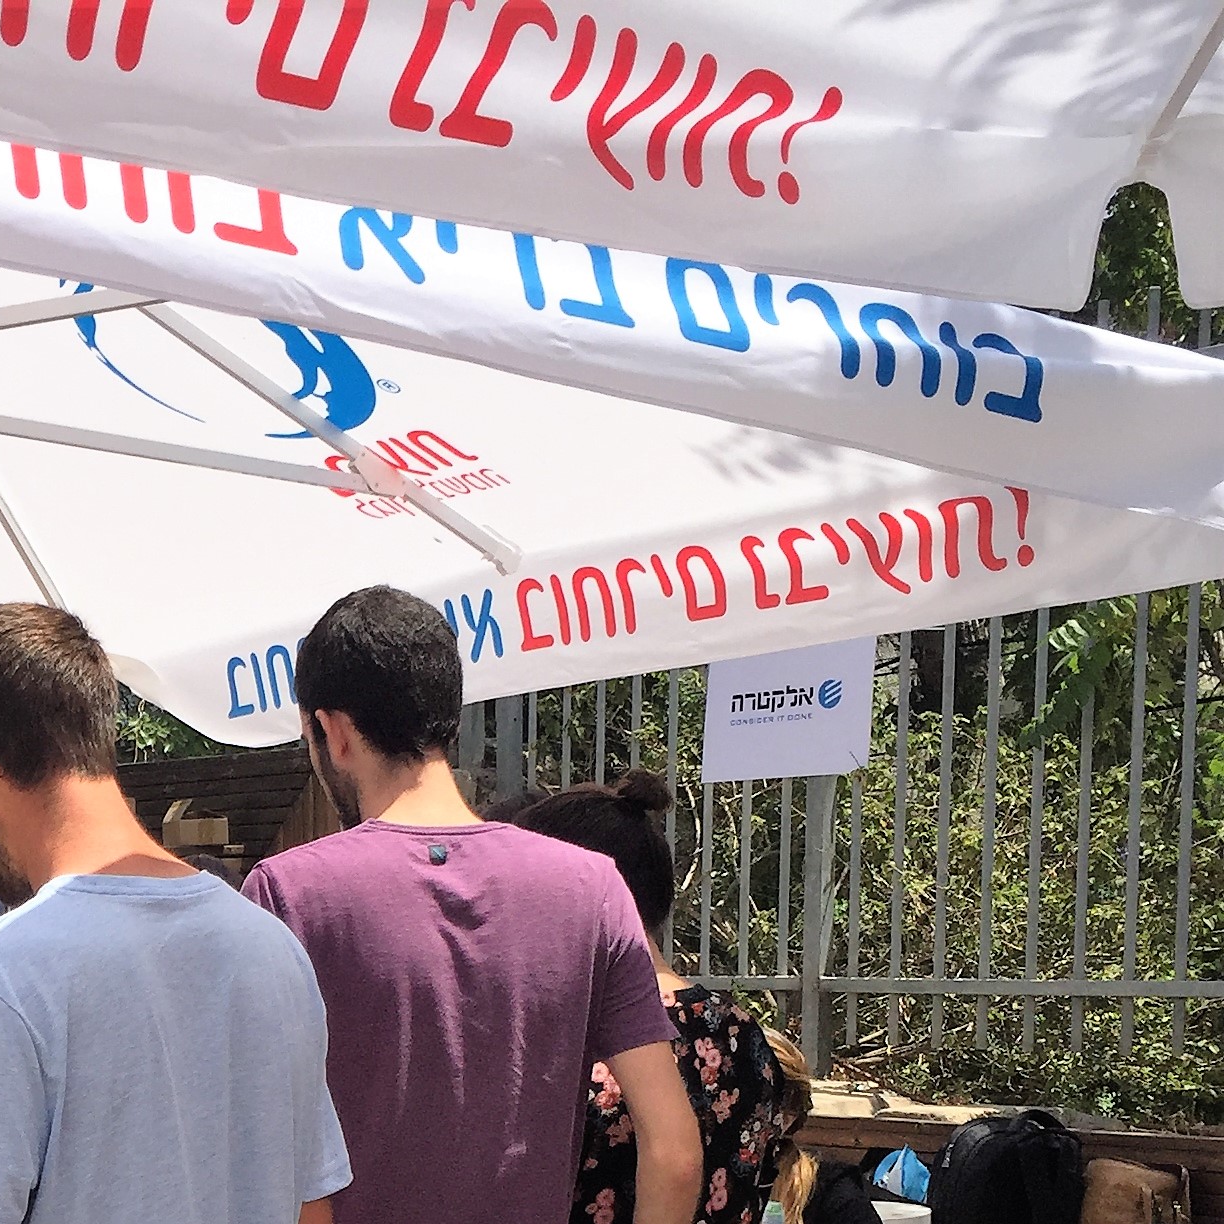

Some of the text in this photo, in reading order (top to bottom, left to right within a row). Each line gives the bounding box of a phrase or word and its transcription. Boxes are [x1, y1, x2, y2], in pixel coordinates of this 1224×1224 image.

[665, 254, 1045, 423] בוחרים
[730, 685, 814, 712] אלקטרה
[730, 715, 774, 727] CONSIDER
[787, 712, 813, 722] DONE
